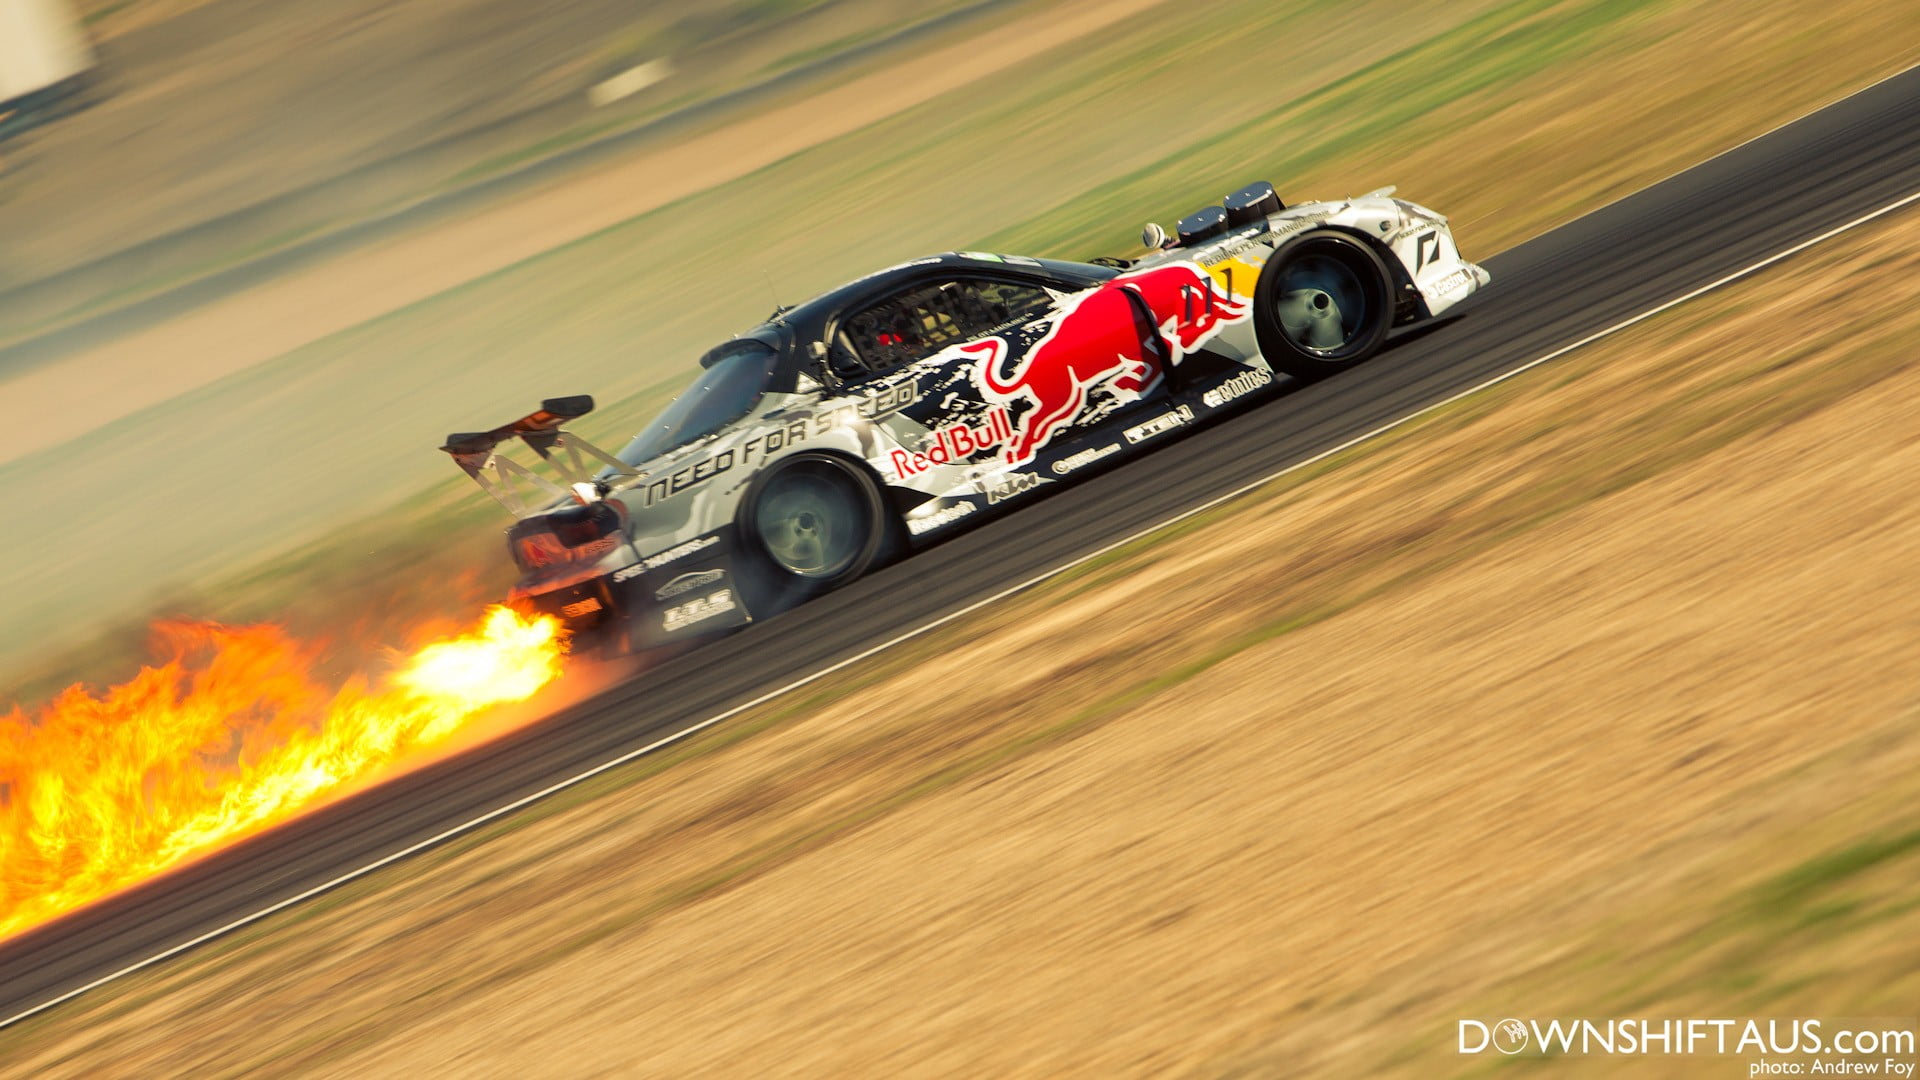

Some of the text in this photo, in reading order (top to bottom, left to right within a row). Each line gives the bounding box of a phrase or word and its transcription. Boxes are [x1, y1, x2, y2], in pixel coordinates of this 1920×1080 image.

[644, 448, 735, 507] NEED
[741, 420, 807, 465] FOR
[891, 408, 1012, 479] Red Bull
[987, 472, 1040, 505] KTM
